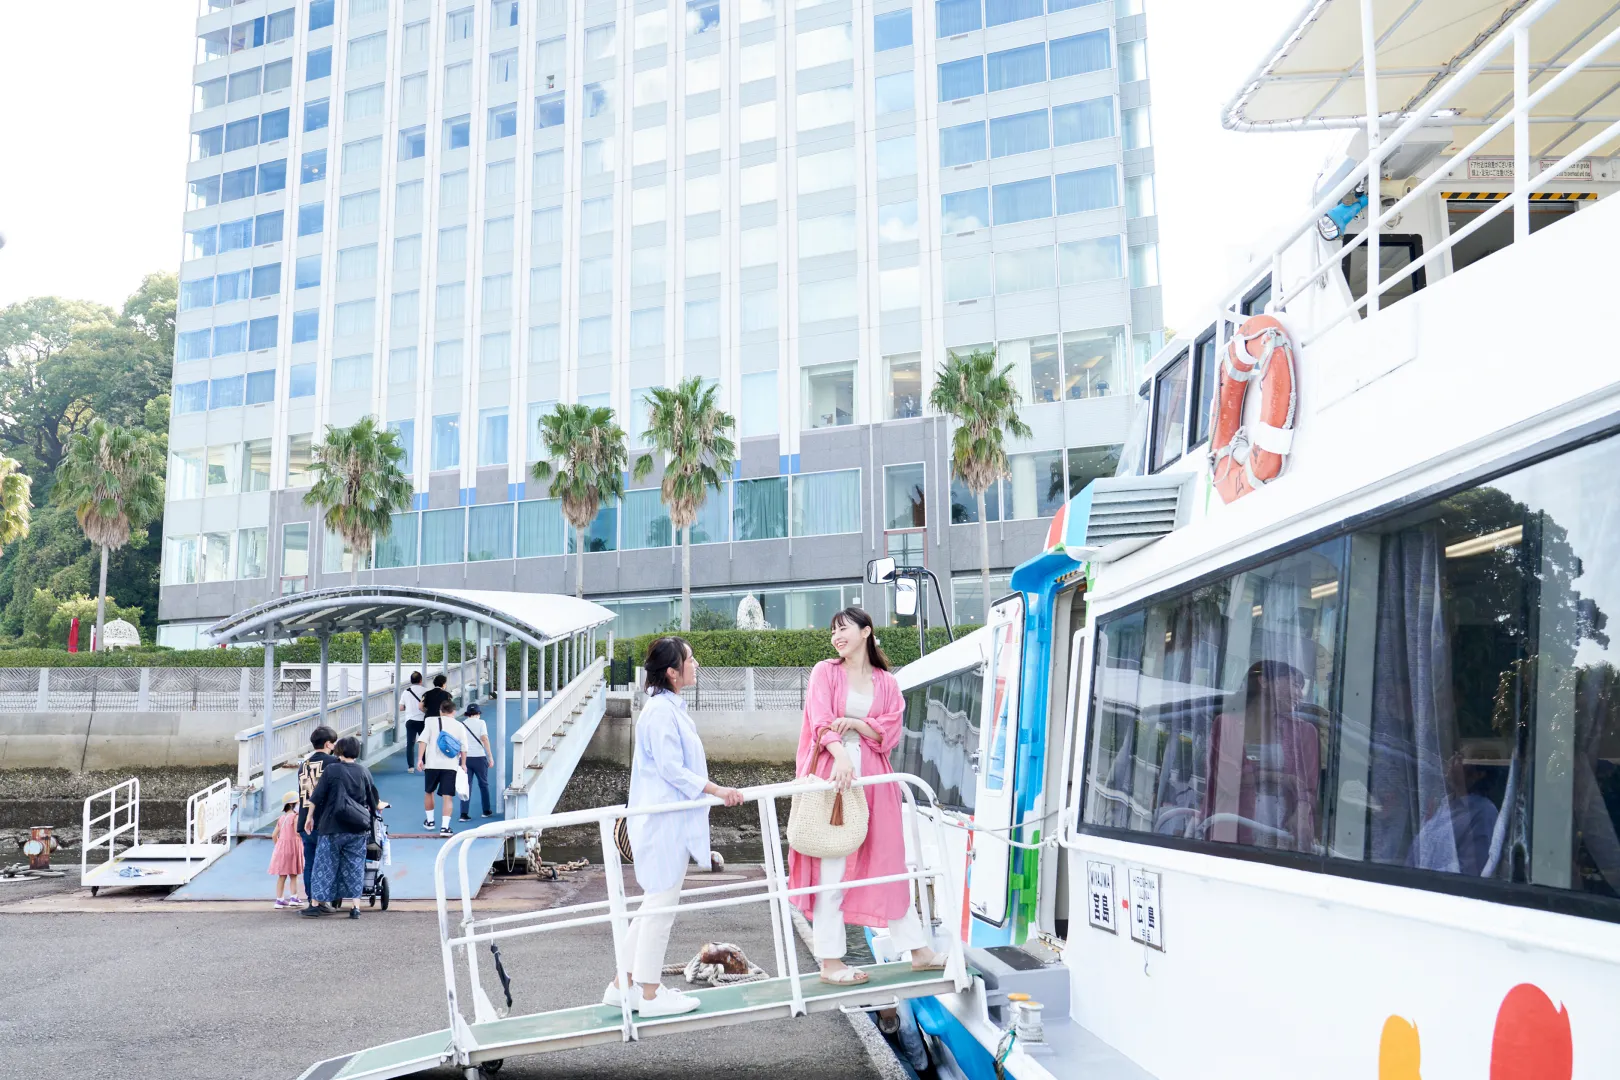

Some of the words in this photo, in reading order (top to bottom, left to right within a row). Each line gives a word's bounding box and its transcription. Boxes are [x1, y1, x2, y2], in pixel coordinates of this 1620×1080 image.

[1090, 870, 1110, 889] MIYAJIMA
[1133, 876, 1155, 890] HIROSHIMA
[1093, 892, 1110, 923] 宮島
[1136, 902, 1155, 929] 広島
